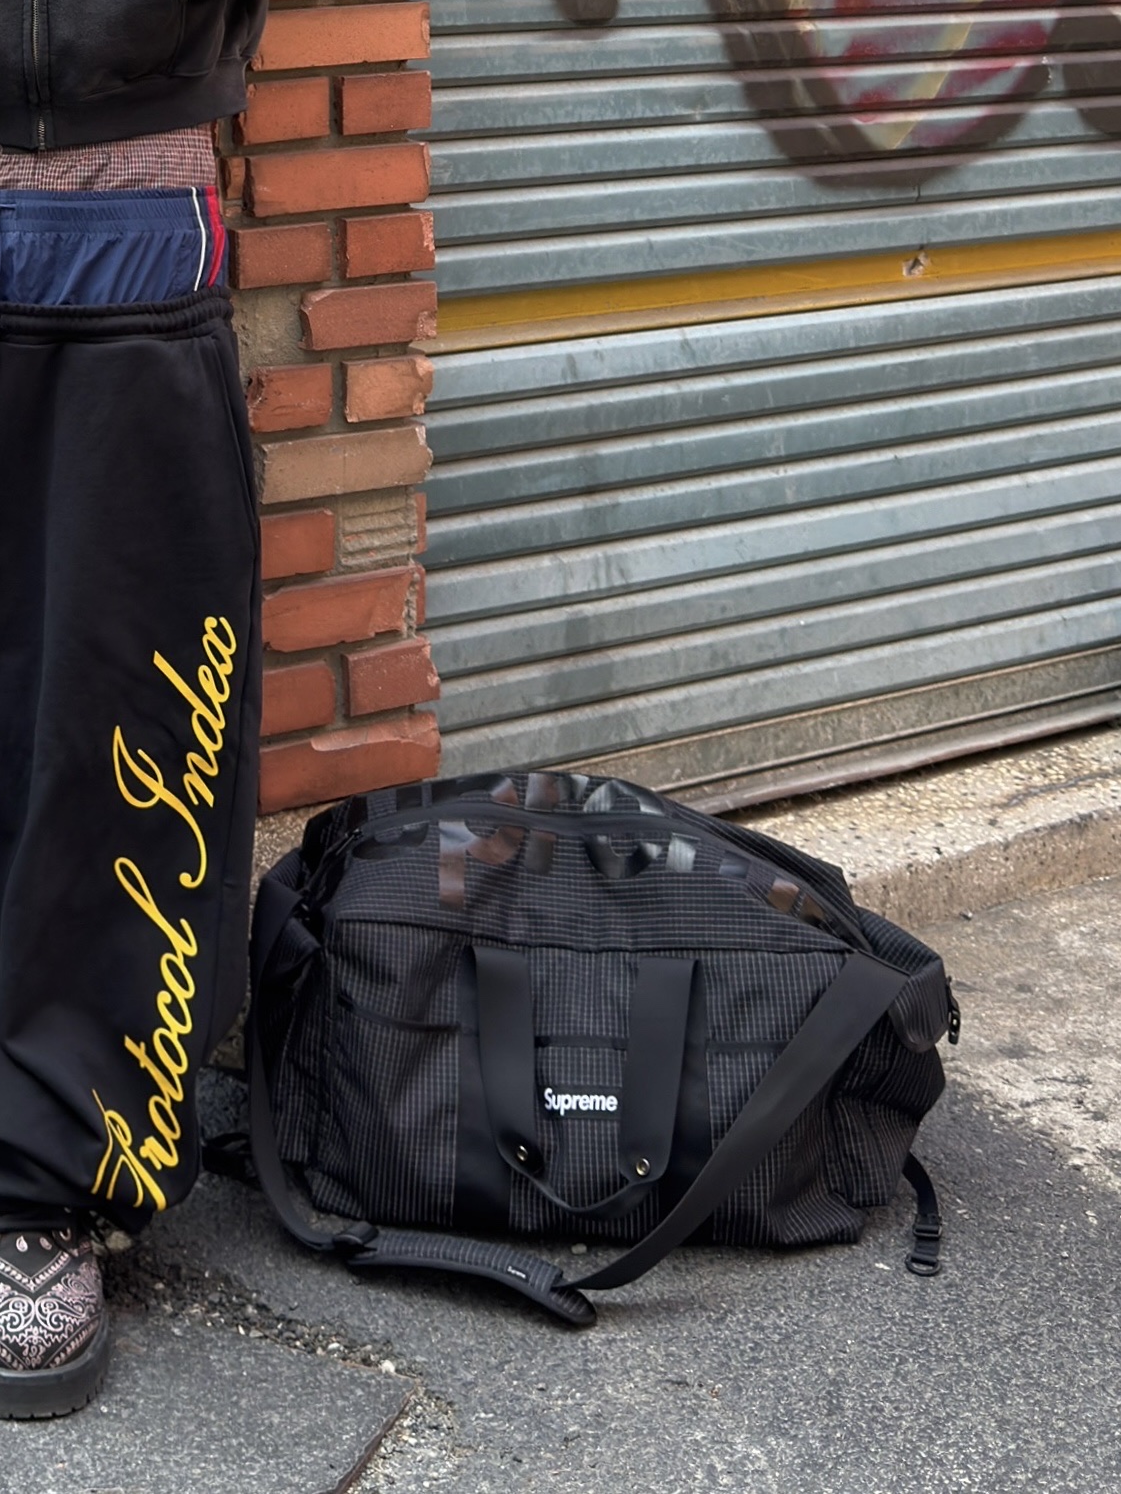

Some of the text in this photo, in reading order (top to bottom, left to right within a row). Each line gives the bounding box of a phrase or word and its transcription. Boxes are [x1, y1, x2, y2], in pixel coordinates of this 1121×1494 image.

[90, 616, 237, 1210] Protocol Index
[544, 1087, 619, 1117] Supreme
